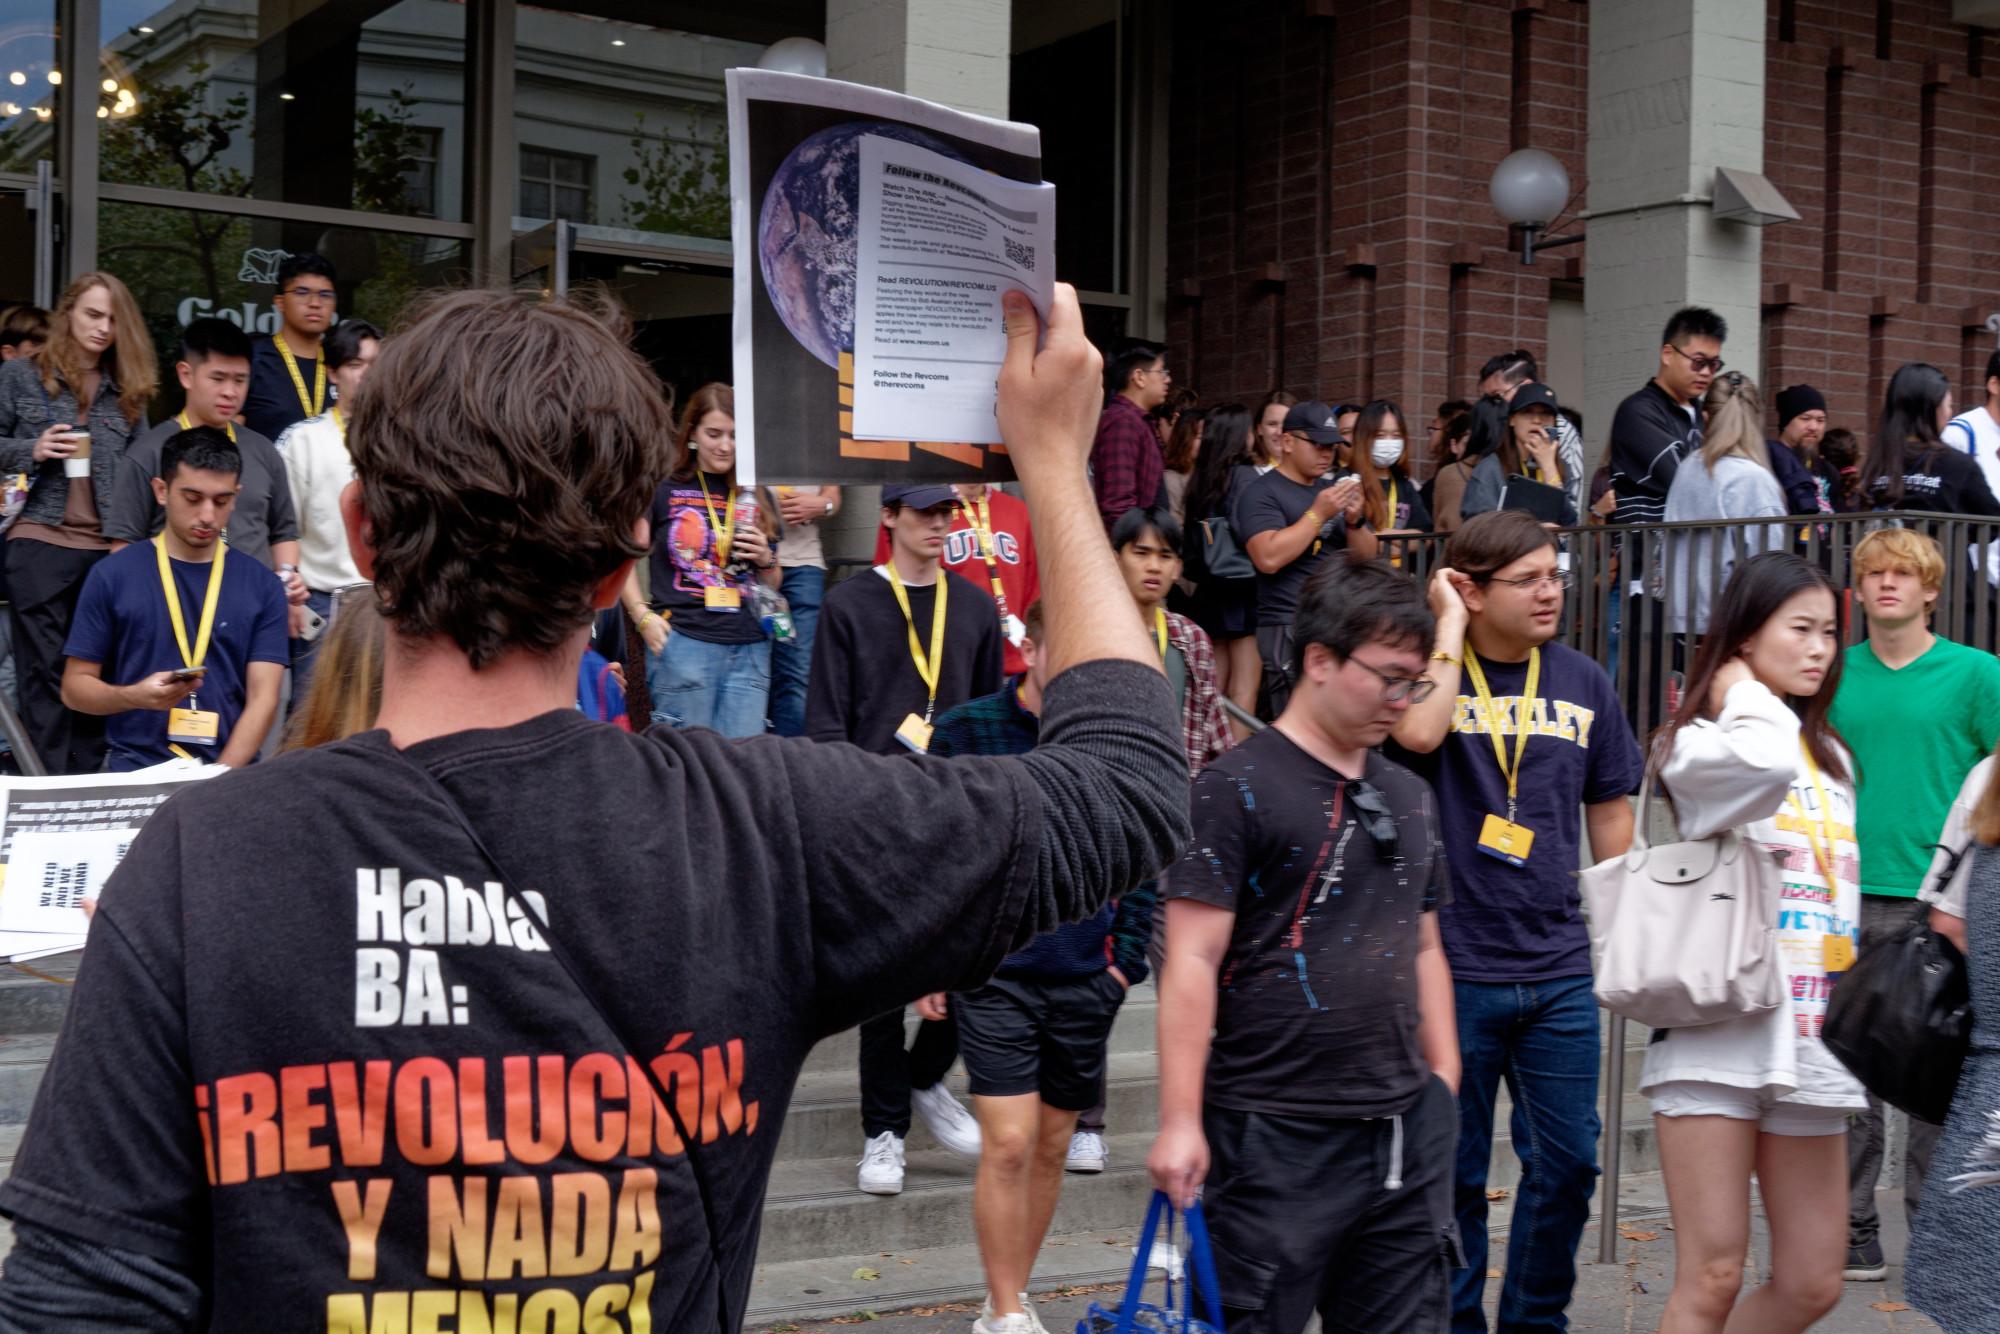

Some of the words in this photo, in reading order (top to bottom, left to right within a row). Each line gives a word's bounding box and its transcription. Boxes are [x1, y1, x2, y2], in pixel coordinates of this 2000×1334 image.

[886, 164, 921, 179] Follow
[923, 172, 942, 184] the
[882, 183, 906, 191] Watch
[882, 190, 903, 198] Show
[914, 194, 947, 207] YouTube
[878, 276, 897, 284] Read
[925, 304, 963, 314] REVOLUTION
[899, 339, 950, 347] www.revcom.us
[874, 369, 899, 378] Follow
[900, 371, 913, 379] the
[914, 372, 949, 381] Revcoms
[874, 380, 925, 390] @therevcoms
[1449, 695, 1595, 749] ERKELEY
[356, 867, 552, 952] Habla
[355, 947, 470, 1027] BA:
[195, 1032, 759, 1186] ¡REVOLUCIÓN,
[331, 1179, 394, 1280] Y
[426, 1168, 662, 1281] NADA
